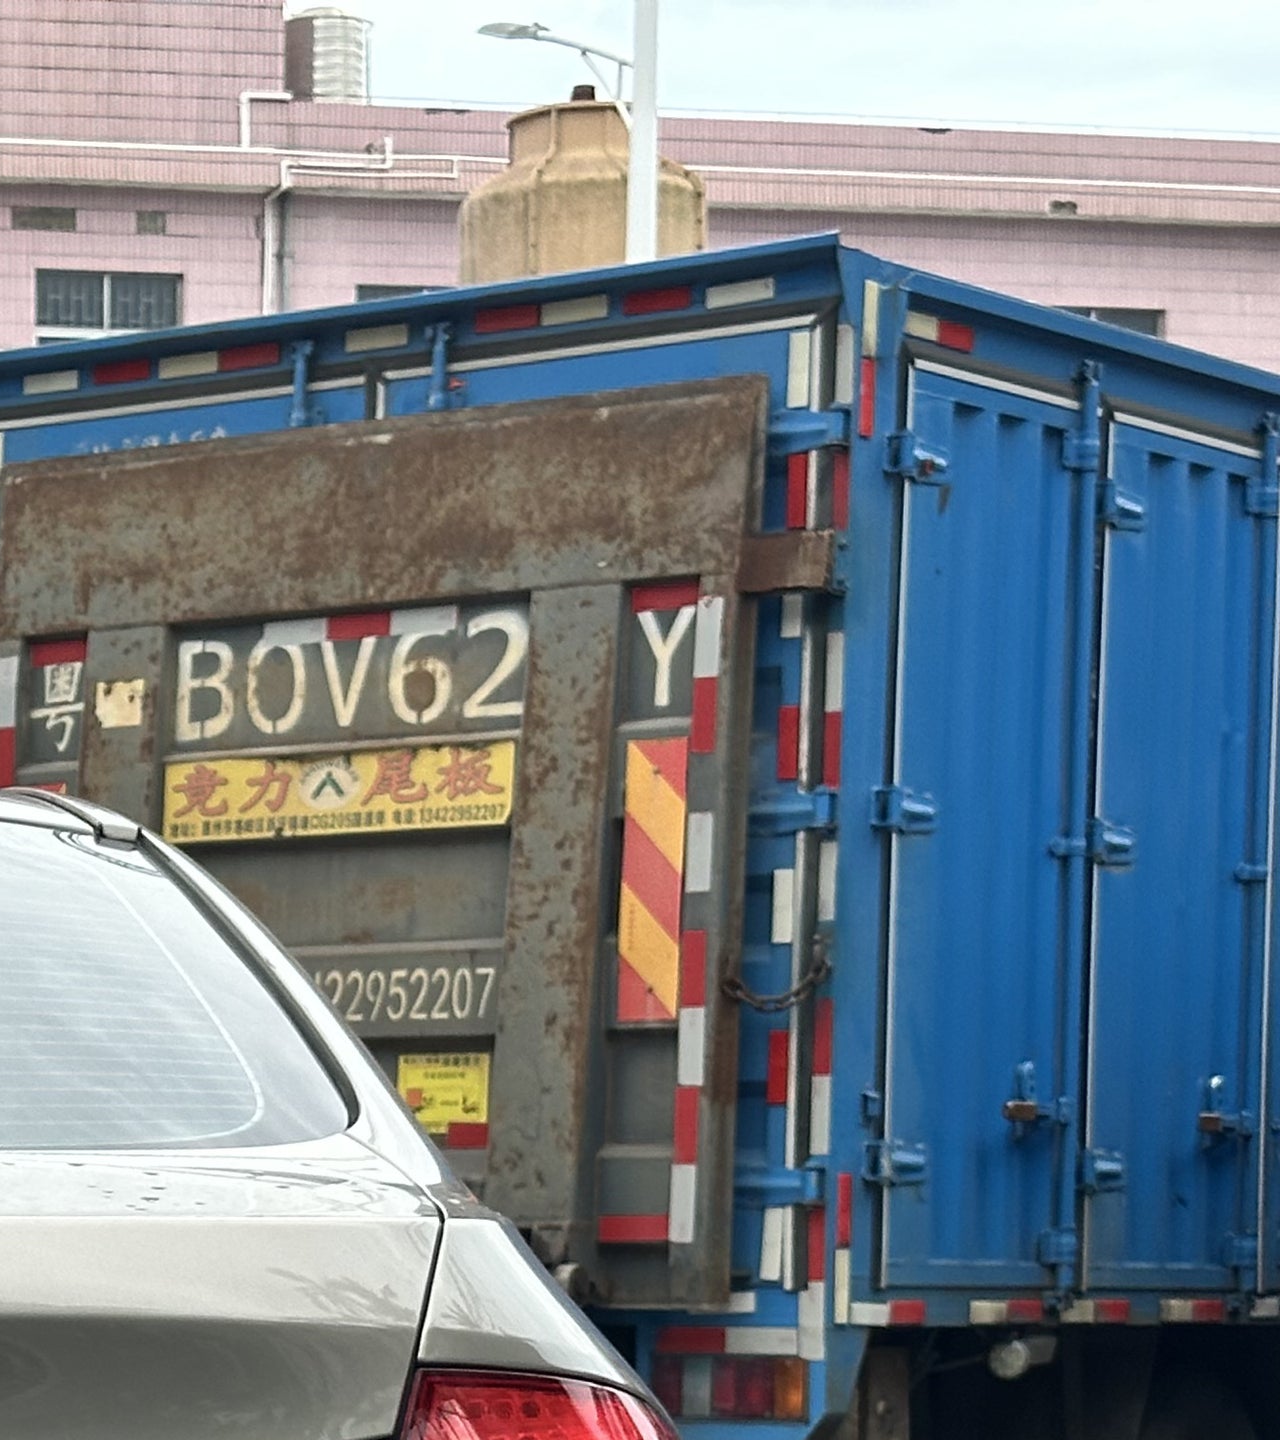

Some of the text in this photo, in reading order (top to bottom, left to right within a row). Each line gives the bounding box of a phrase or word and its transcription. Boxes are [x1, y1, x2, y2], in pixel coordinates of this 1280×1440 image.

[31, 662, 85, 752] 粤
[638, 605, 697, 708] Y
[360, 749, 504, 807] 尾板
[314, 967, 496, 1022] 22952207
